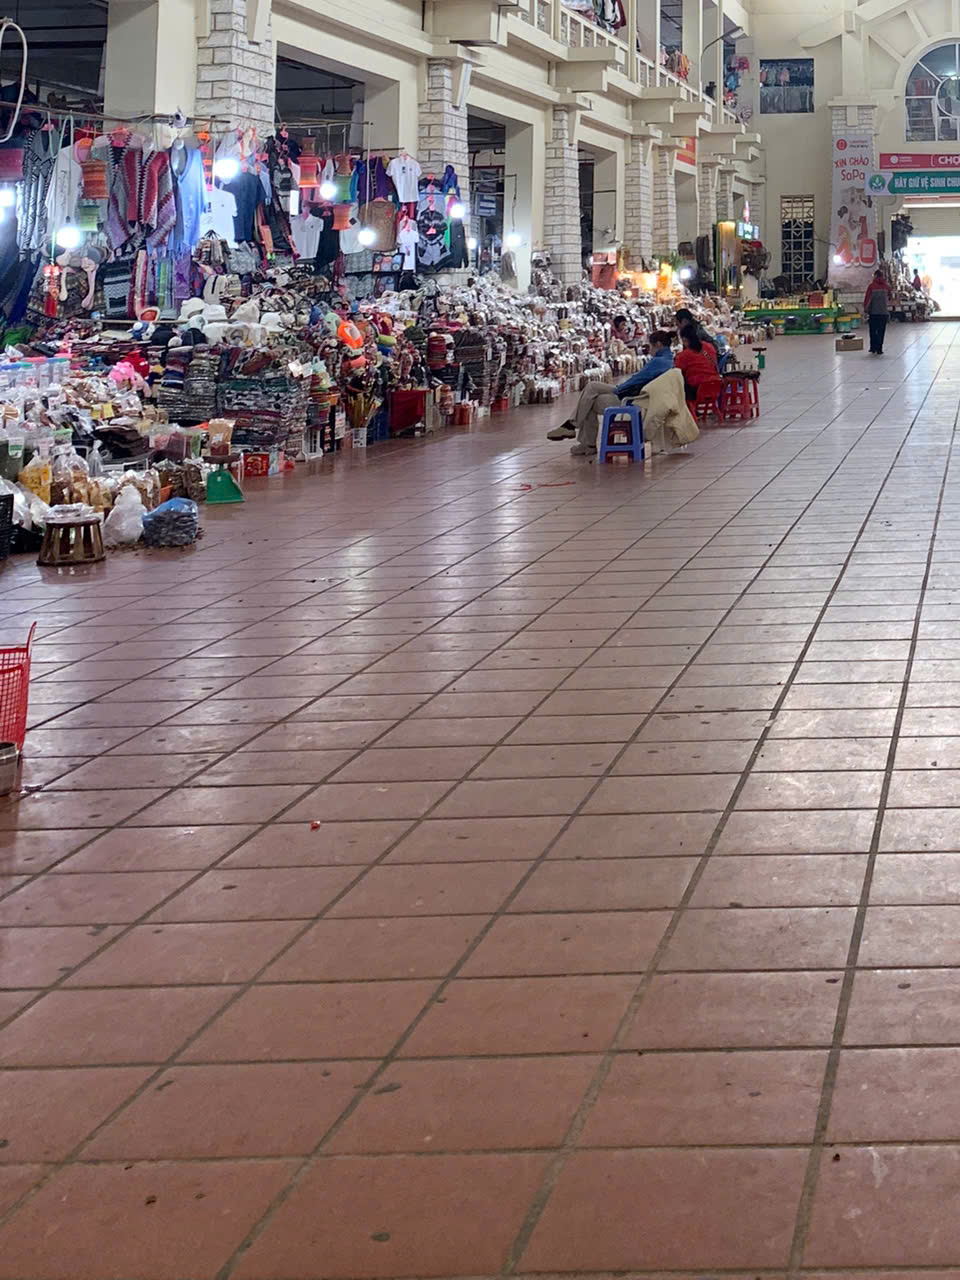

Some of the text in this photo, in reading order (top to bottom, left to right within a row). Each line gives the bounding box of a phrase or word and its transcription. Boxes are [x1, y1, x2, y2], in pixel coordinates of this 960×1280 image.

[938, 155, 960, 166] CHỢ
[841, 168, 865, 181] SaPa
[920, 175, 929, 190] VỆ
[930, 176, 946, 187] SINH
